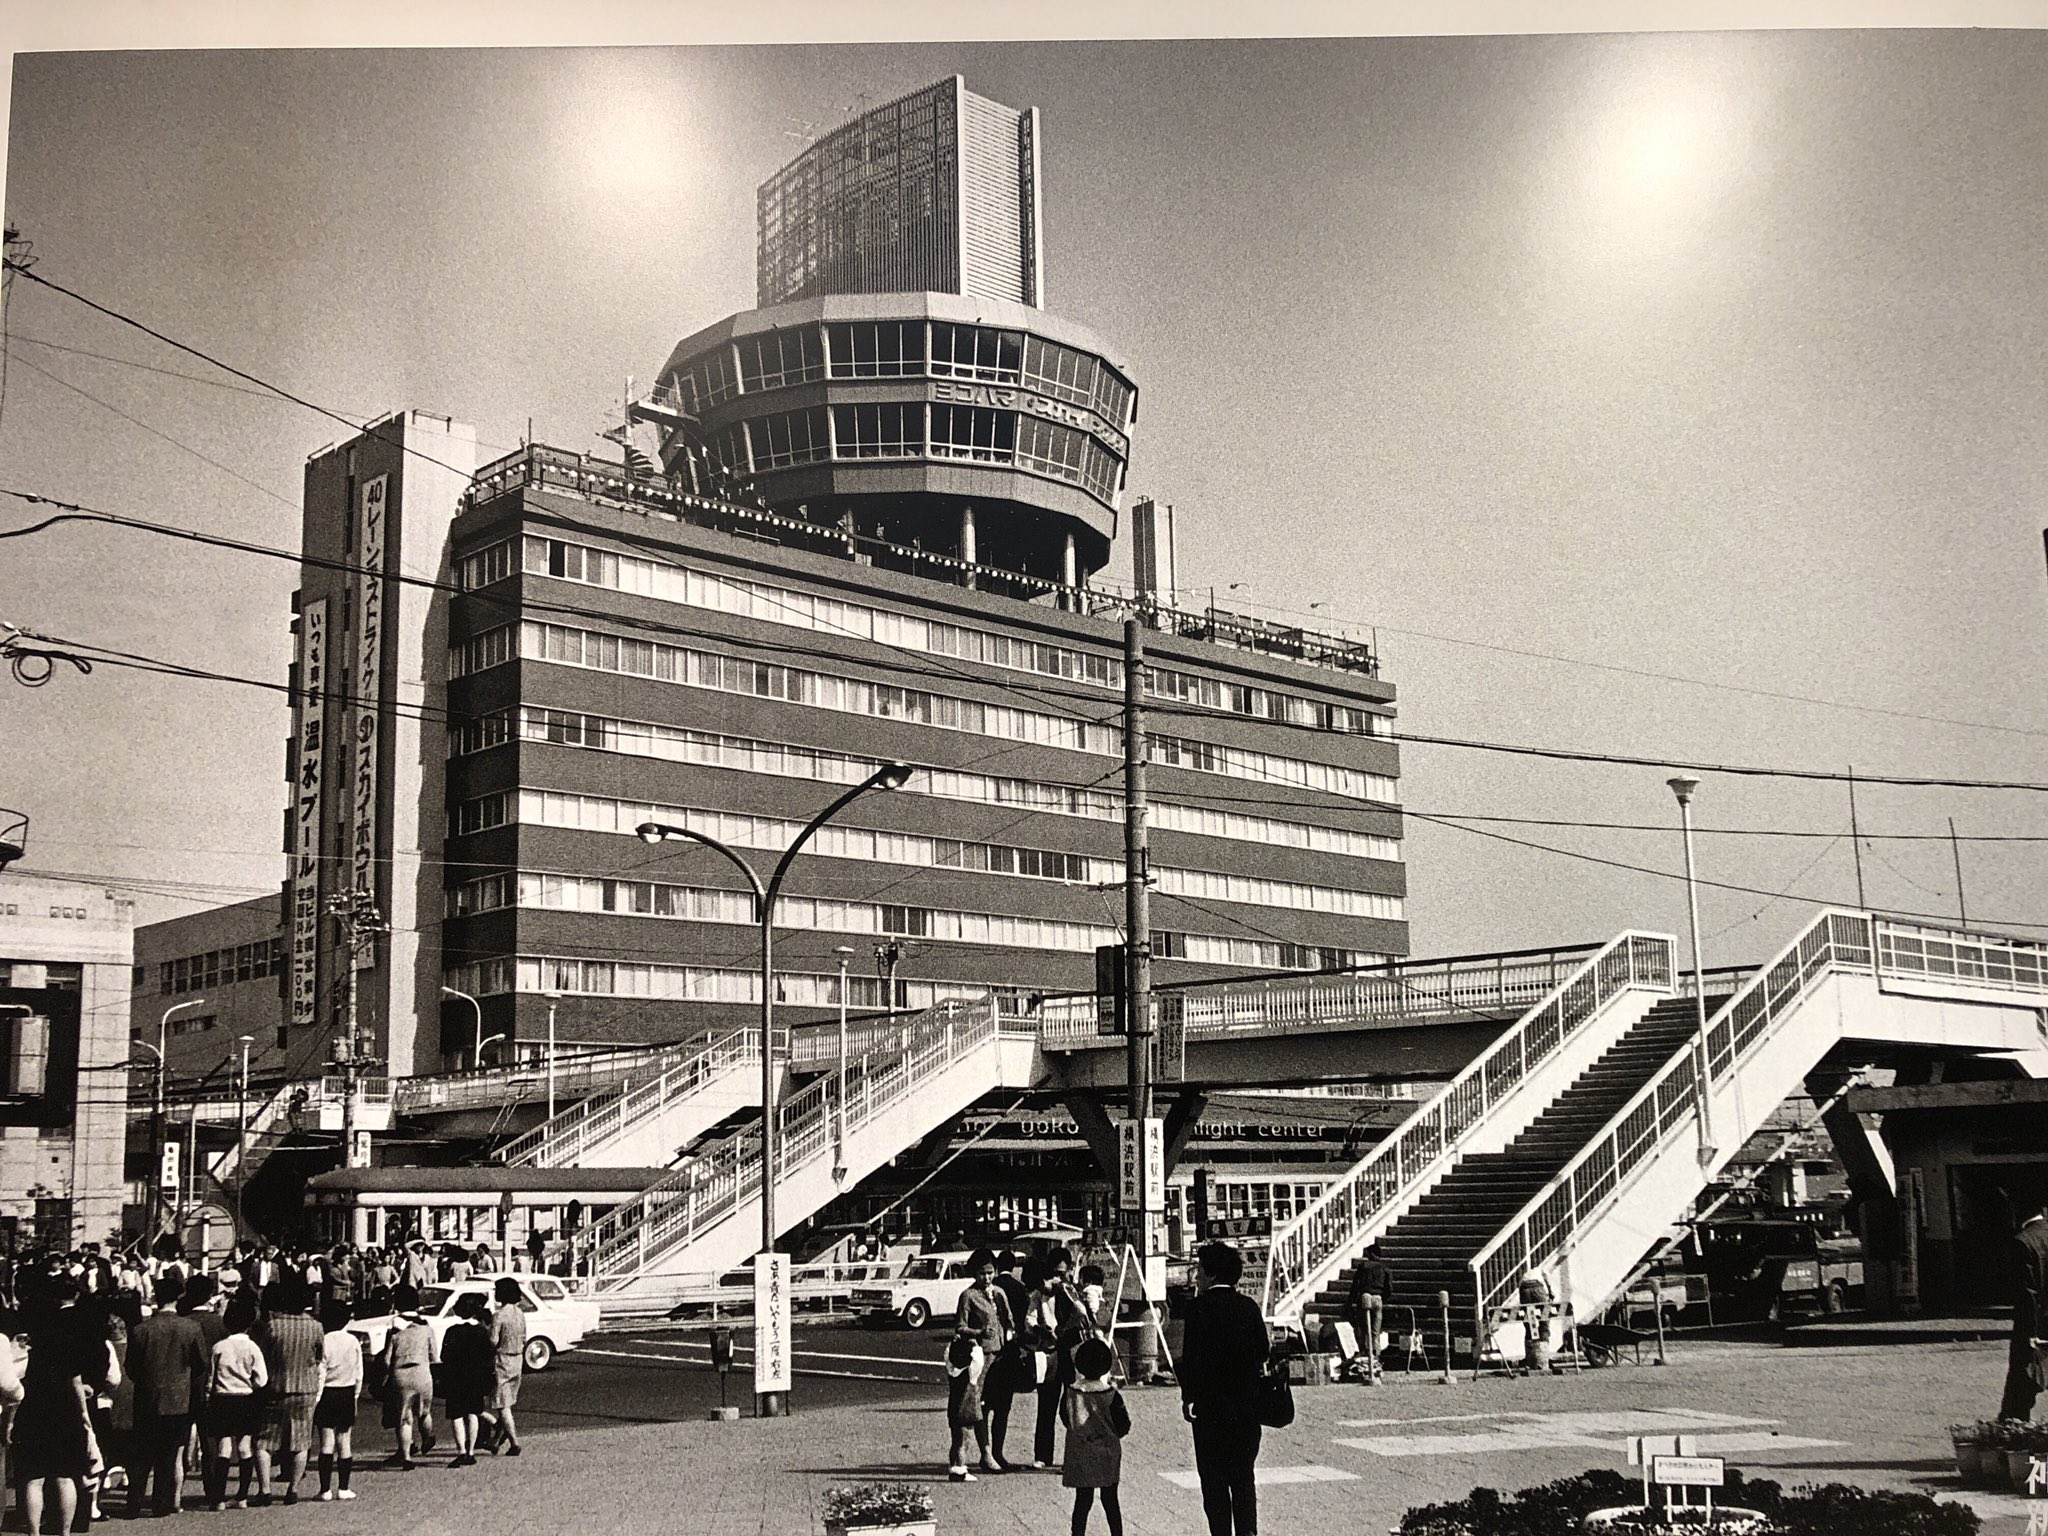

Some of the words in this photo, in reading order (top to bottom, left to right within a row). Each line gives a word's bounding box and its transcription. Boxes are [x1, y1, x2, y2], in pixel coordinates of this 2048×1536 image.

[935, 381, 1016, 407] ヨコハマ
[1258, 1122, 1327, 1137] center
[1123, 1125, 1135, 1196] 横浜駅前
[1149, 1125, 1160, 1196] 横浜駅前
